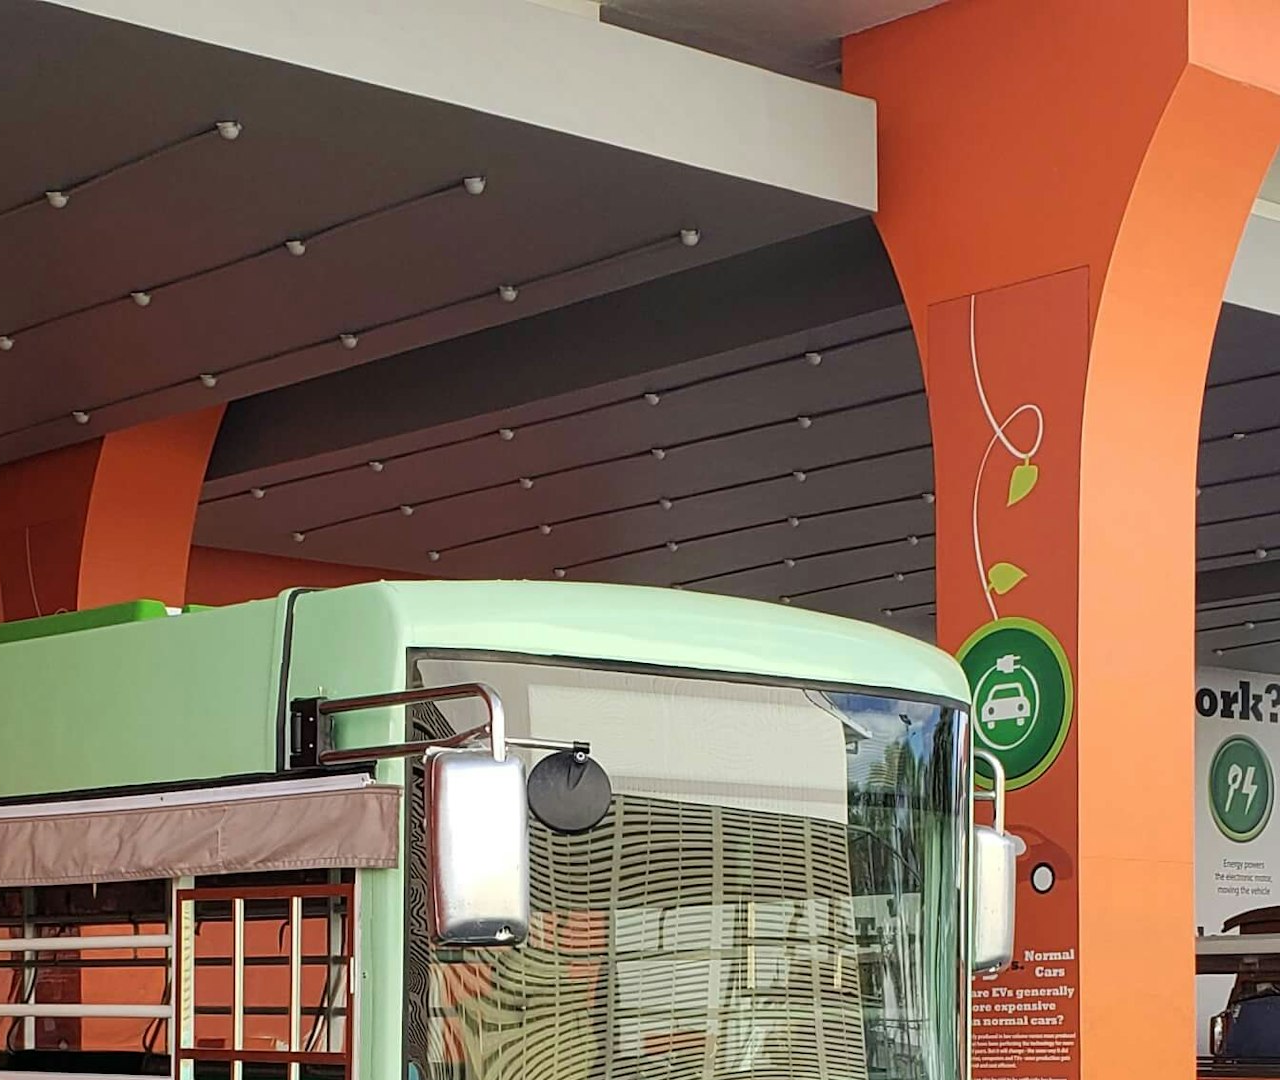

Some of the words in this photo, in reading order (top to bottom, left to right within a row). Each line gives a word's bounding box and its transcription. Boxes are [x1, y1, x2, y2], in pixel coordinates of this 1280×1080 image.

[1024, 949, 1075, 962] Normal
[1034, 966, 1065, 978] Cars
[991, 987, 1014, 998] EVs
[1015, 985, 1075, 999] generally
[972, 1003, 992, 1012] ore
[994, 1001, 1056, 1014] expensive
[983, 1015, 1028, 1026] normal
[1030, 1015, 1064, 1026] cars?
